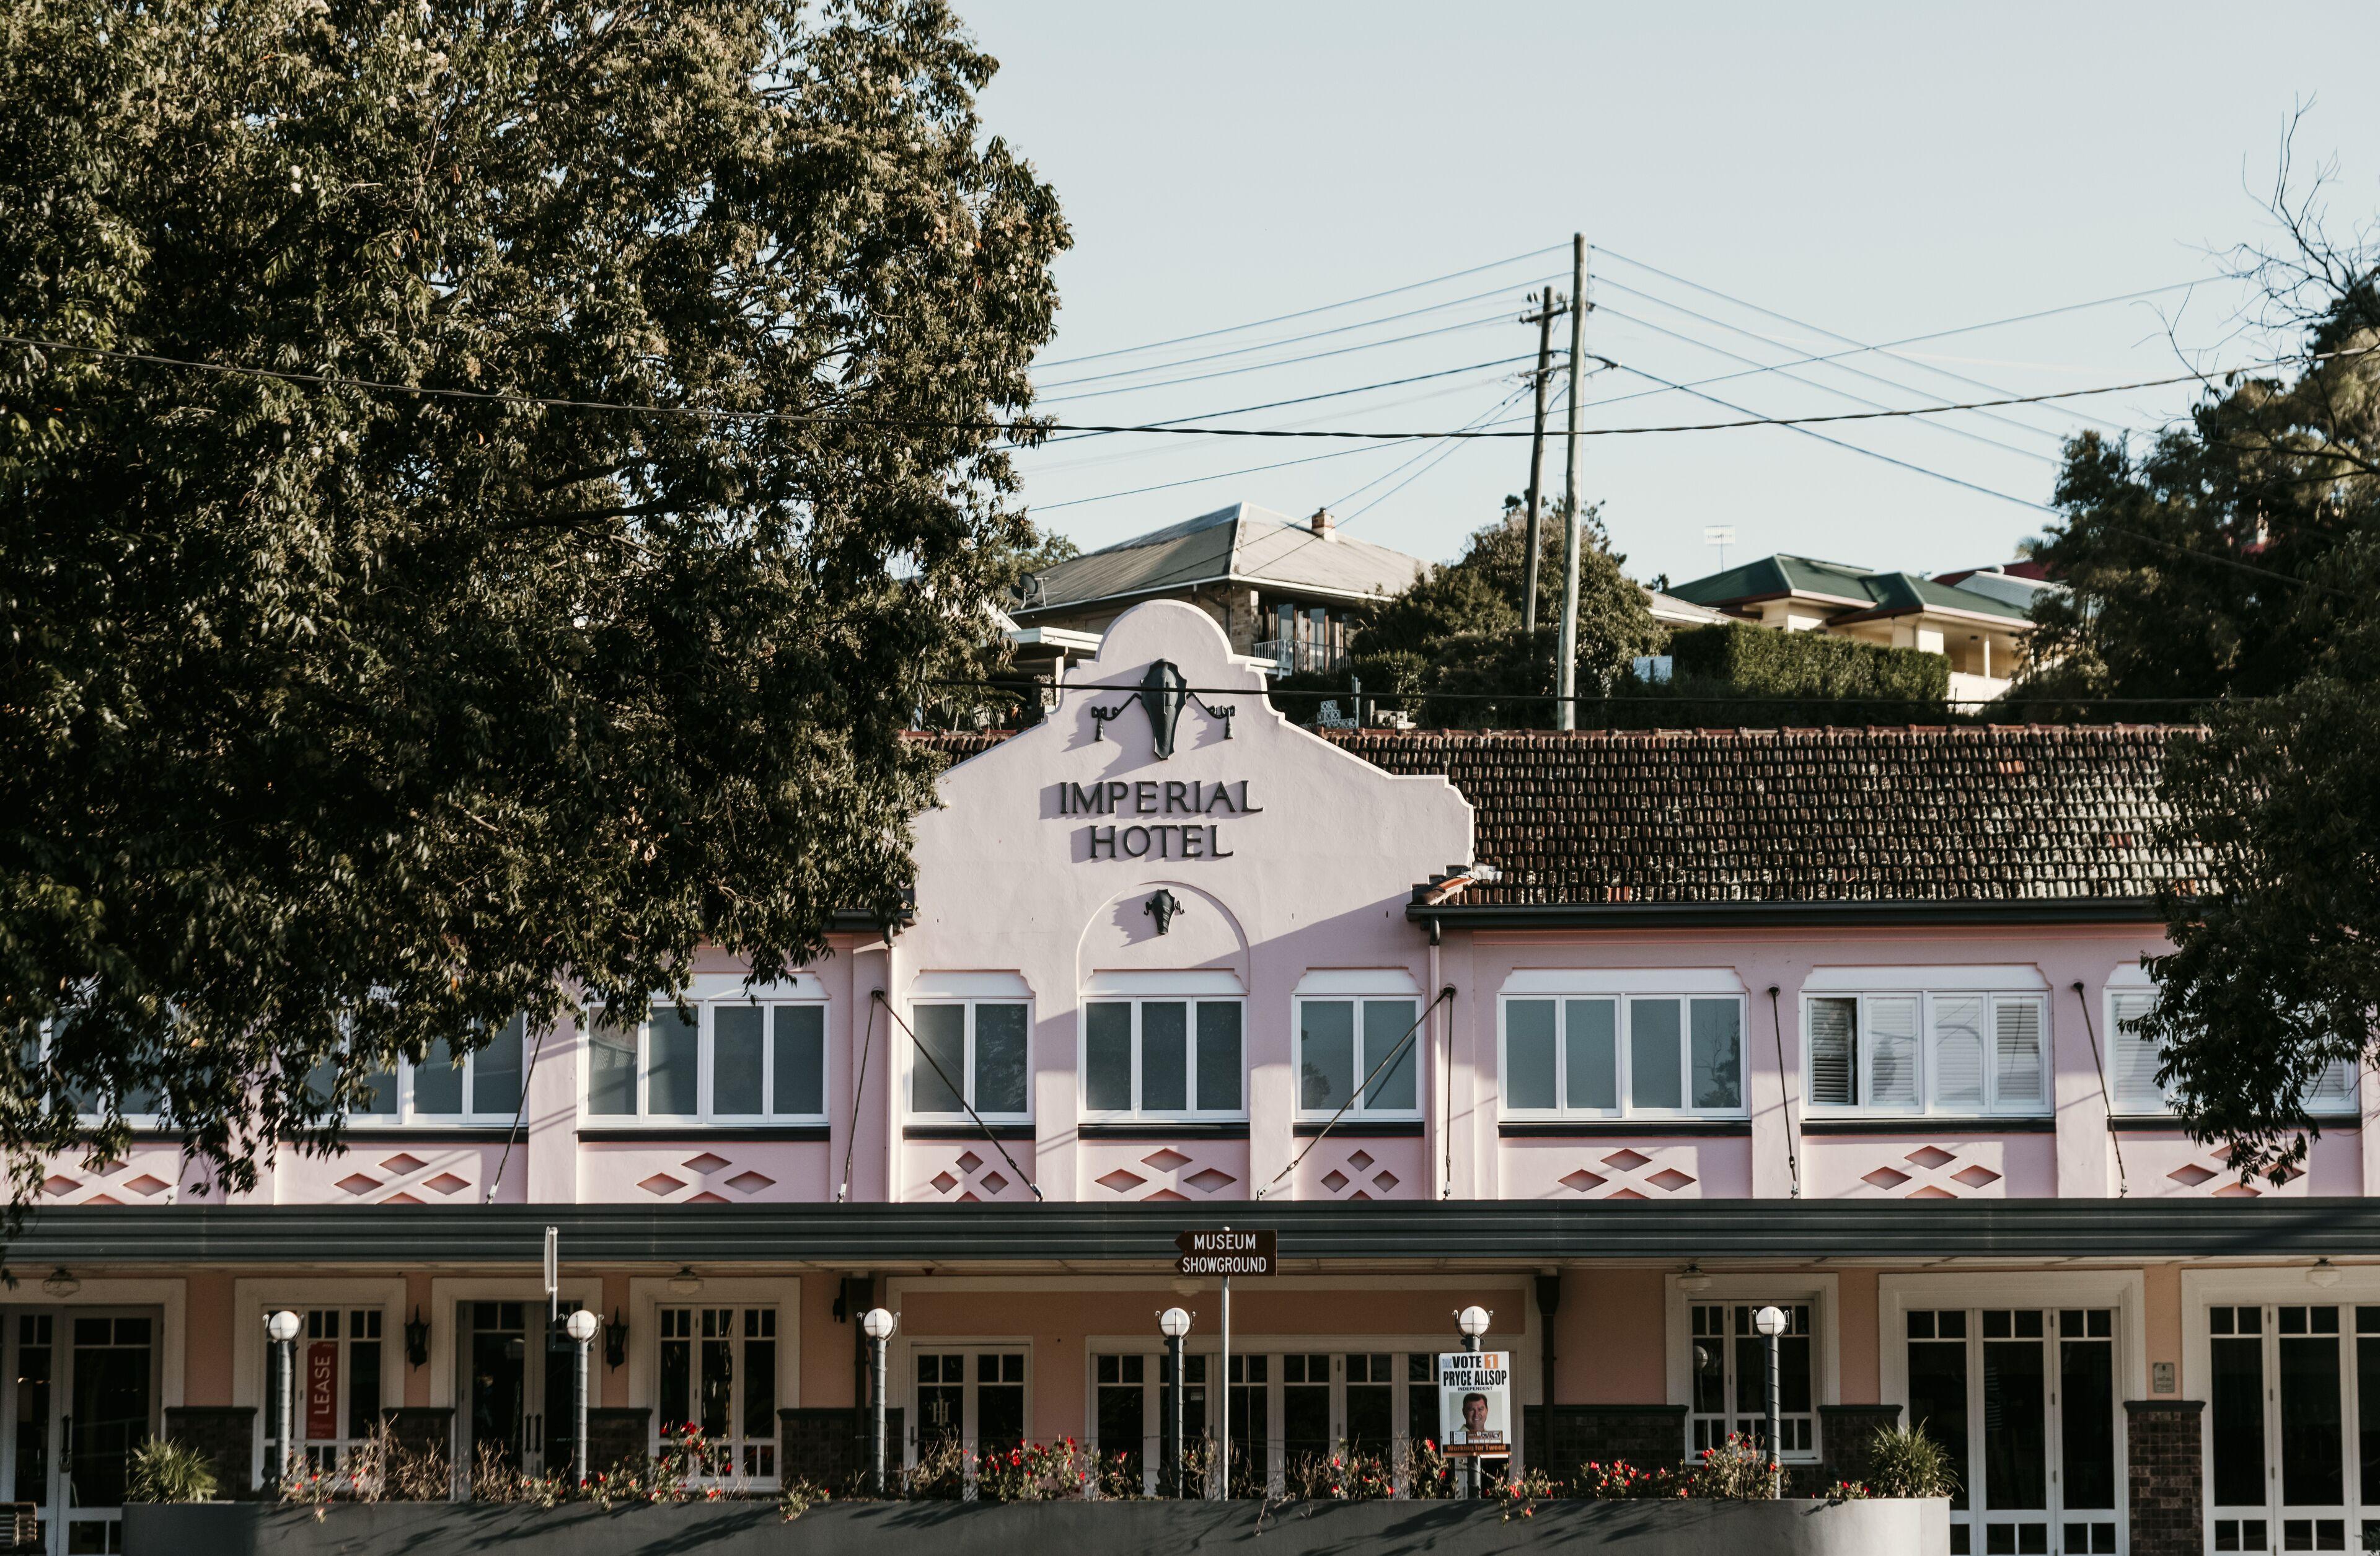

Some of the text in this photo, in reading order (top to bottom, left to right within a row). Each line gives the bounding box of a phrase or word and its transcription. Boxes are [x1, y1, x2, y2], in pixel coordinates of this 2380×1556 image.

[1060, 780, 1264, 814] IMPERIAL
[1089, 824, 1234, 858] HOTEL
[1194, 1234, 1256, 1250] MUSEUM
[1182, 1257, 1267, 1273] SHOWGROUND
[1452, 1355, 1494, 1369] VOTE 1
[314, 1355, 331, 1415] LEASE
[1443, 1369, 1507, 1386] PRYCE ALLSOP
